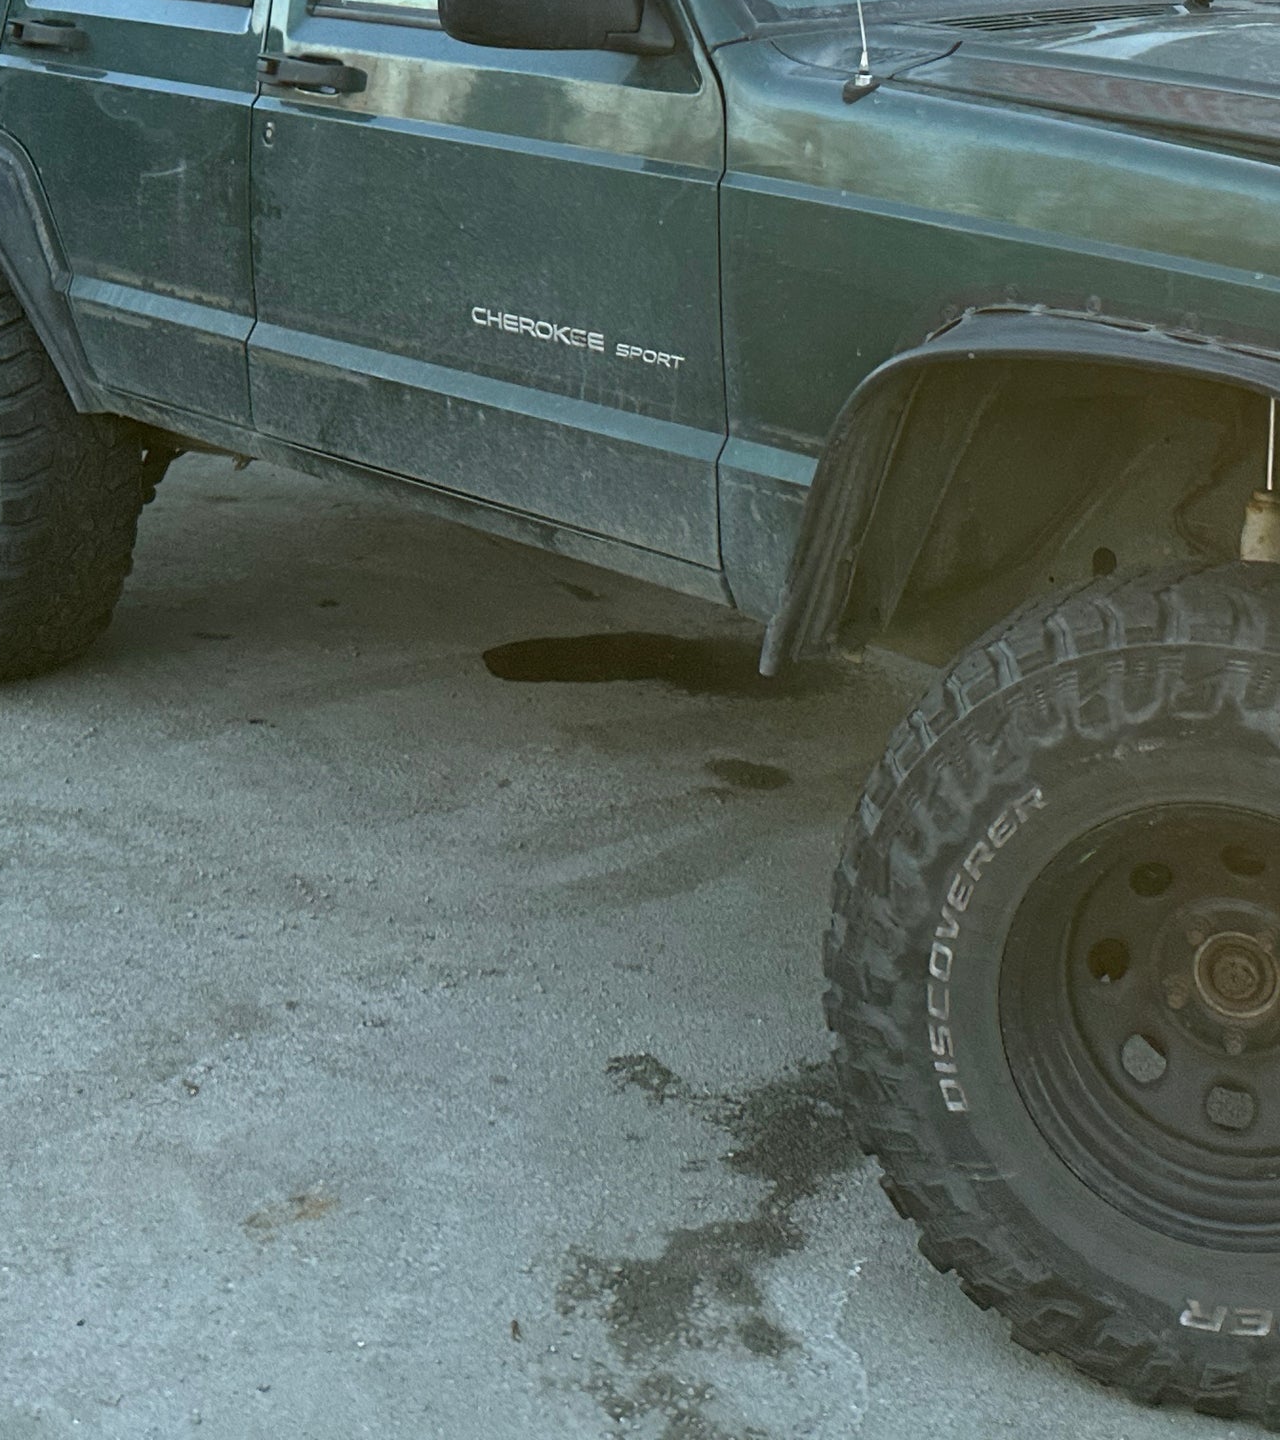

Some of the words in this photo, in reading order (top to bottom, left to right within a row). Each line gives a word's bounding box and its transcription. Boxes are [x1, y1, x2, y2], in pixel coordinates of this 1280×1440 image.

[470, 306, 605, 352] CHEROKEE
[615, 342, 685, 369] SPORT
[927, 786, 1048, 1113] DISCOVERER
